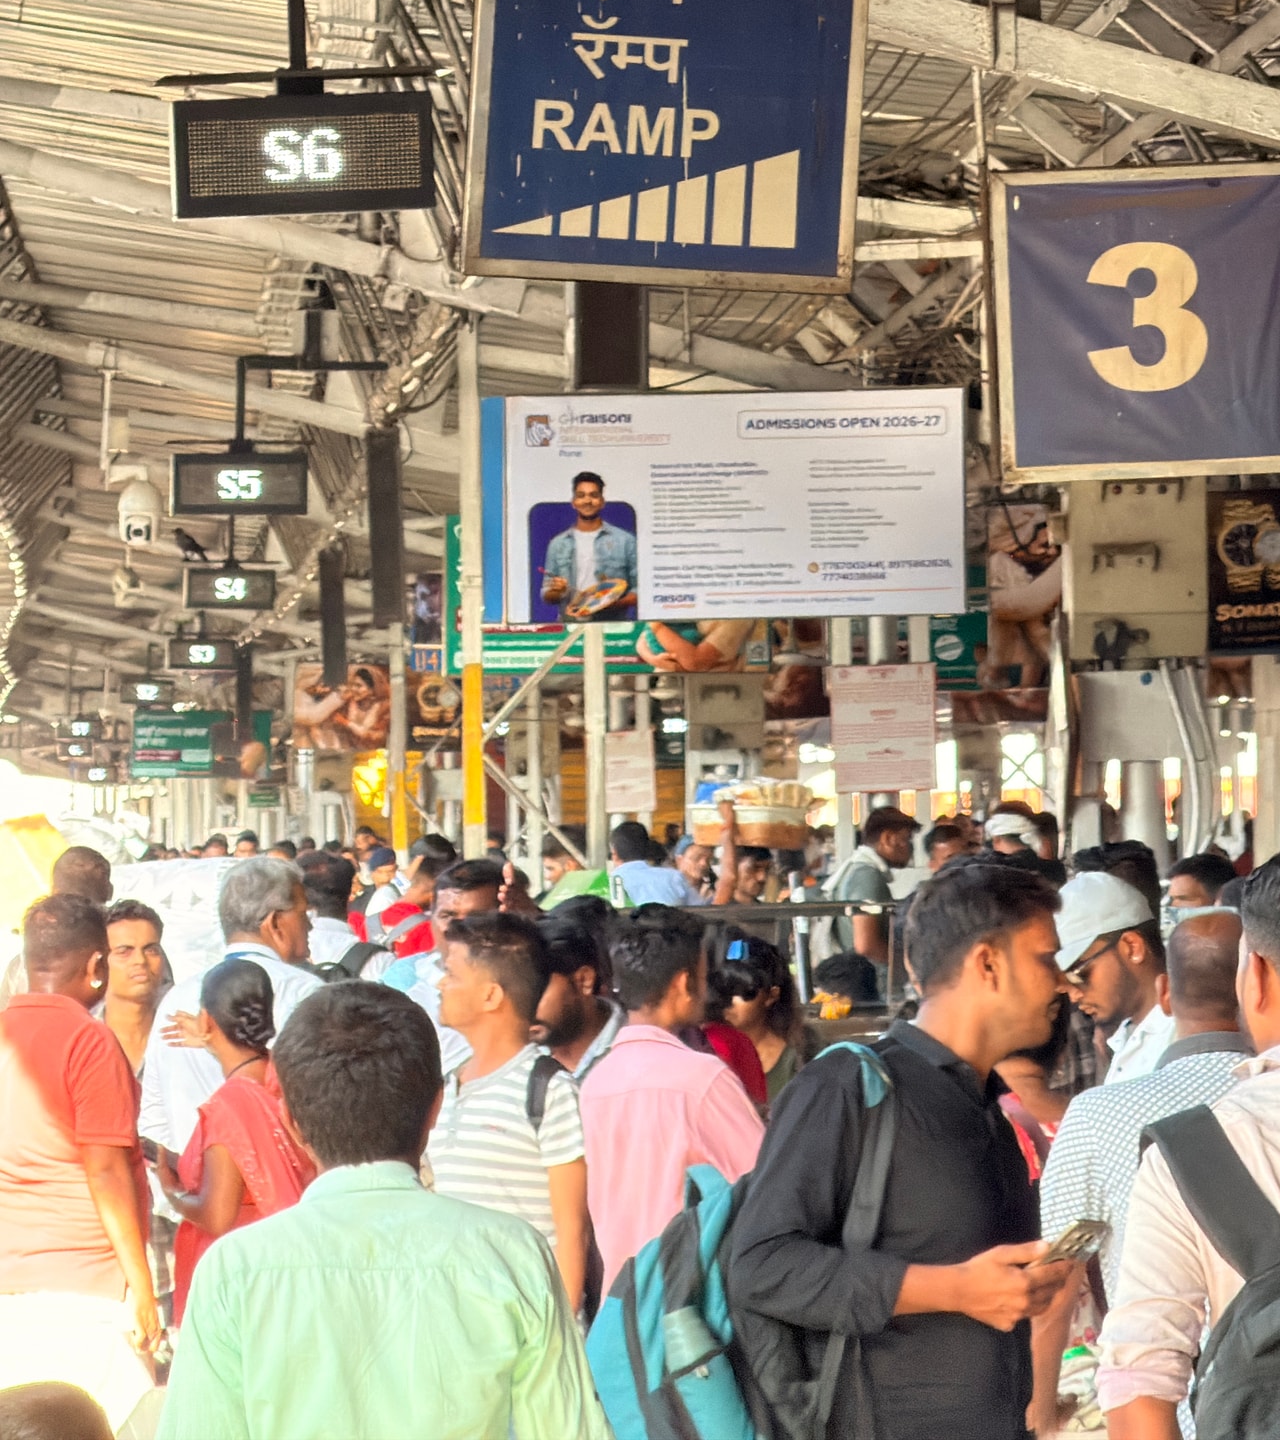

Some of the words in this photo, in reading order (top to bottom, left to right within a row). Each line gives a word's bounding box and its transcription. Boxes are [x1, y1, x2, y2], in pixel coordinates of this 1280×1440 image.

[571, 15, 687, 83] रॅम्प
[531, 99, 720, 158] RAMP
[263, 128, 342, 181] S6
[1086, 241, 1209, 393] 3
[745, 416, 837, 431] ADMISSIONS
[840, 415, 880, 430] OPEN
[883, 414, 941, 429] 2026-27
[216, 470, 262, 501] S5
[214, 578, 248, 601] S4
[188, 645, 216, 664] S3
